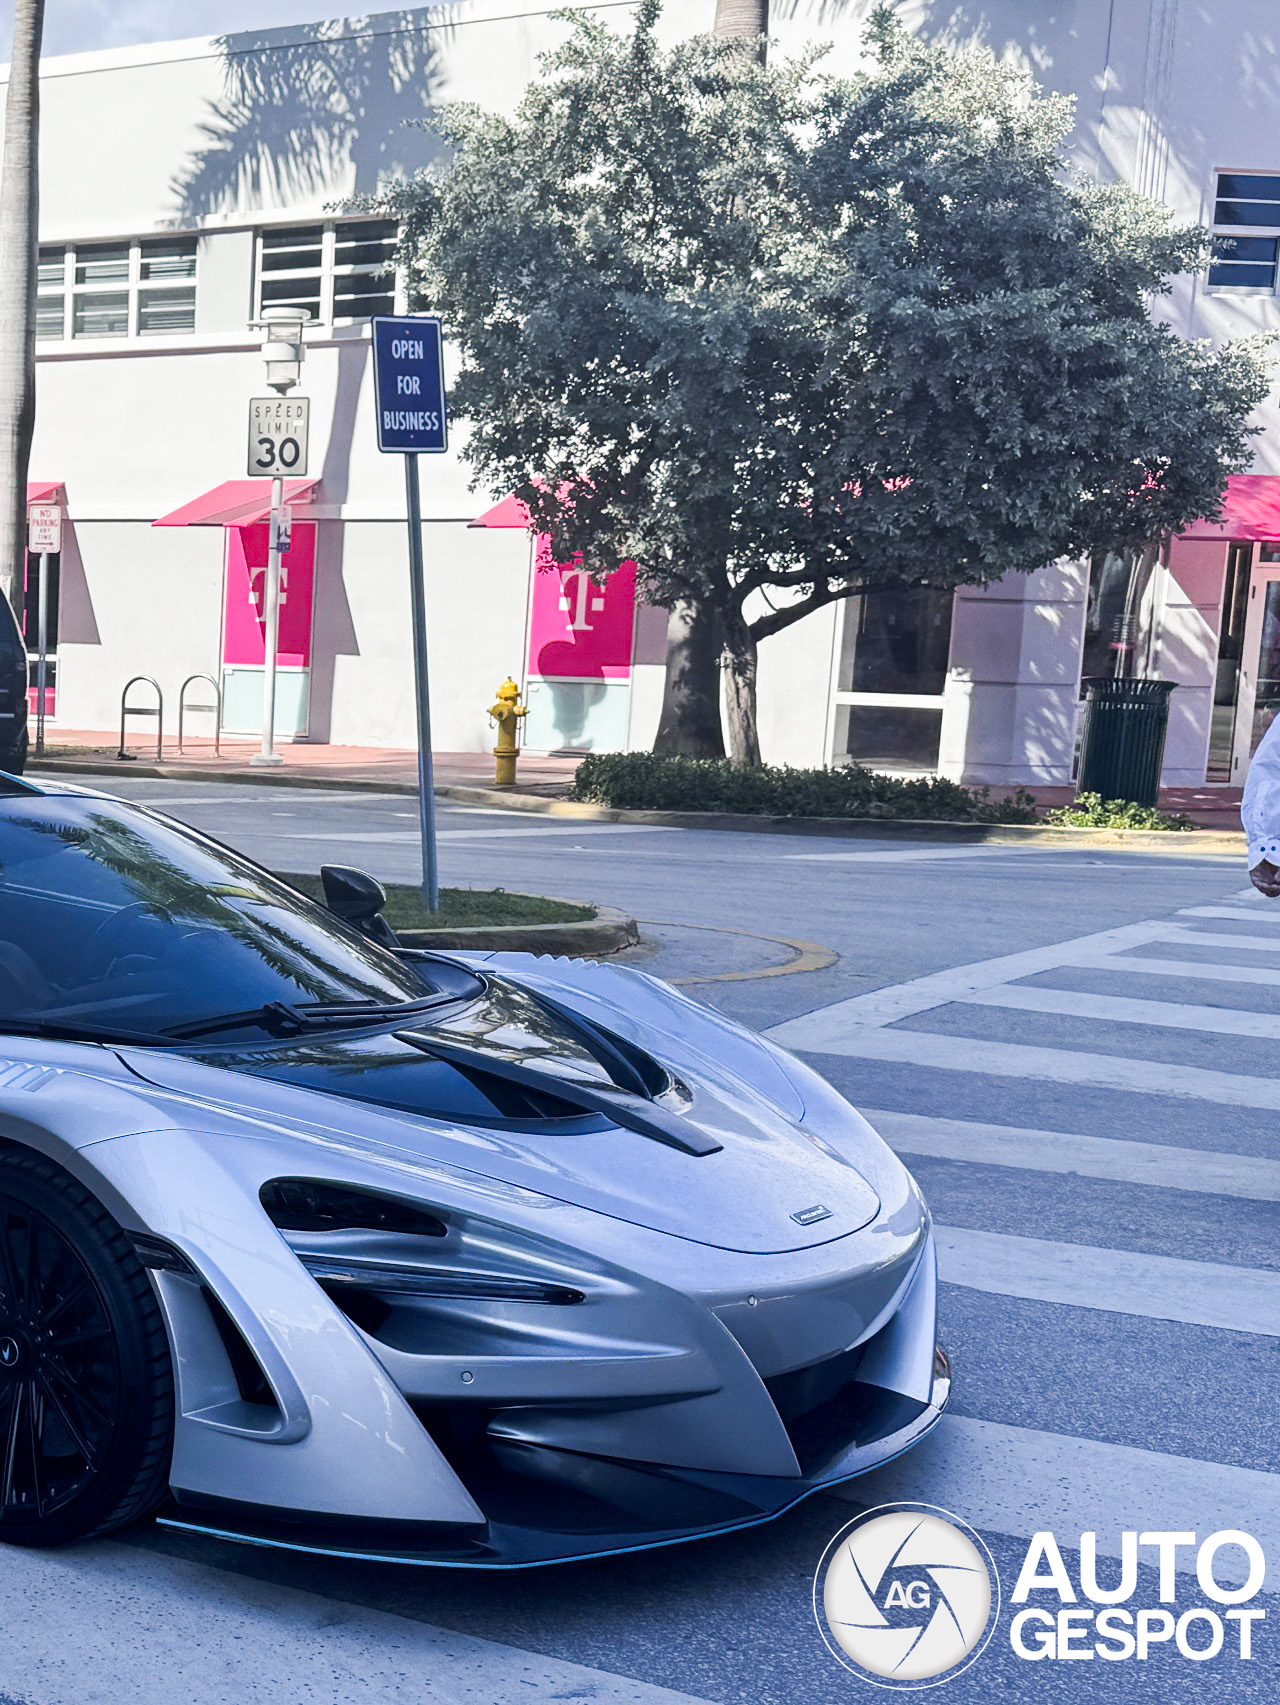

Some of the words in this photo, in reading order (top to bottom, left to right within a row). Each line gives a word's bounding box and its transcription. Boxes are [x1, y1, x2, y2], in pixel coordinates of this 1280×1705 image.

[391, 339, 424, 360] OPEN
[396, 375, 421, 395] FOR
[254, 405, 303, 418] SPEED
[383, 410, 439, 431] BUSINESS
[255, 437, 300, 468] 30
[40, 509, 52, 518] NO
[558, 569, 607, 631] T
